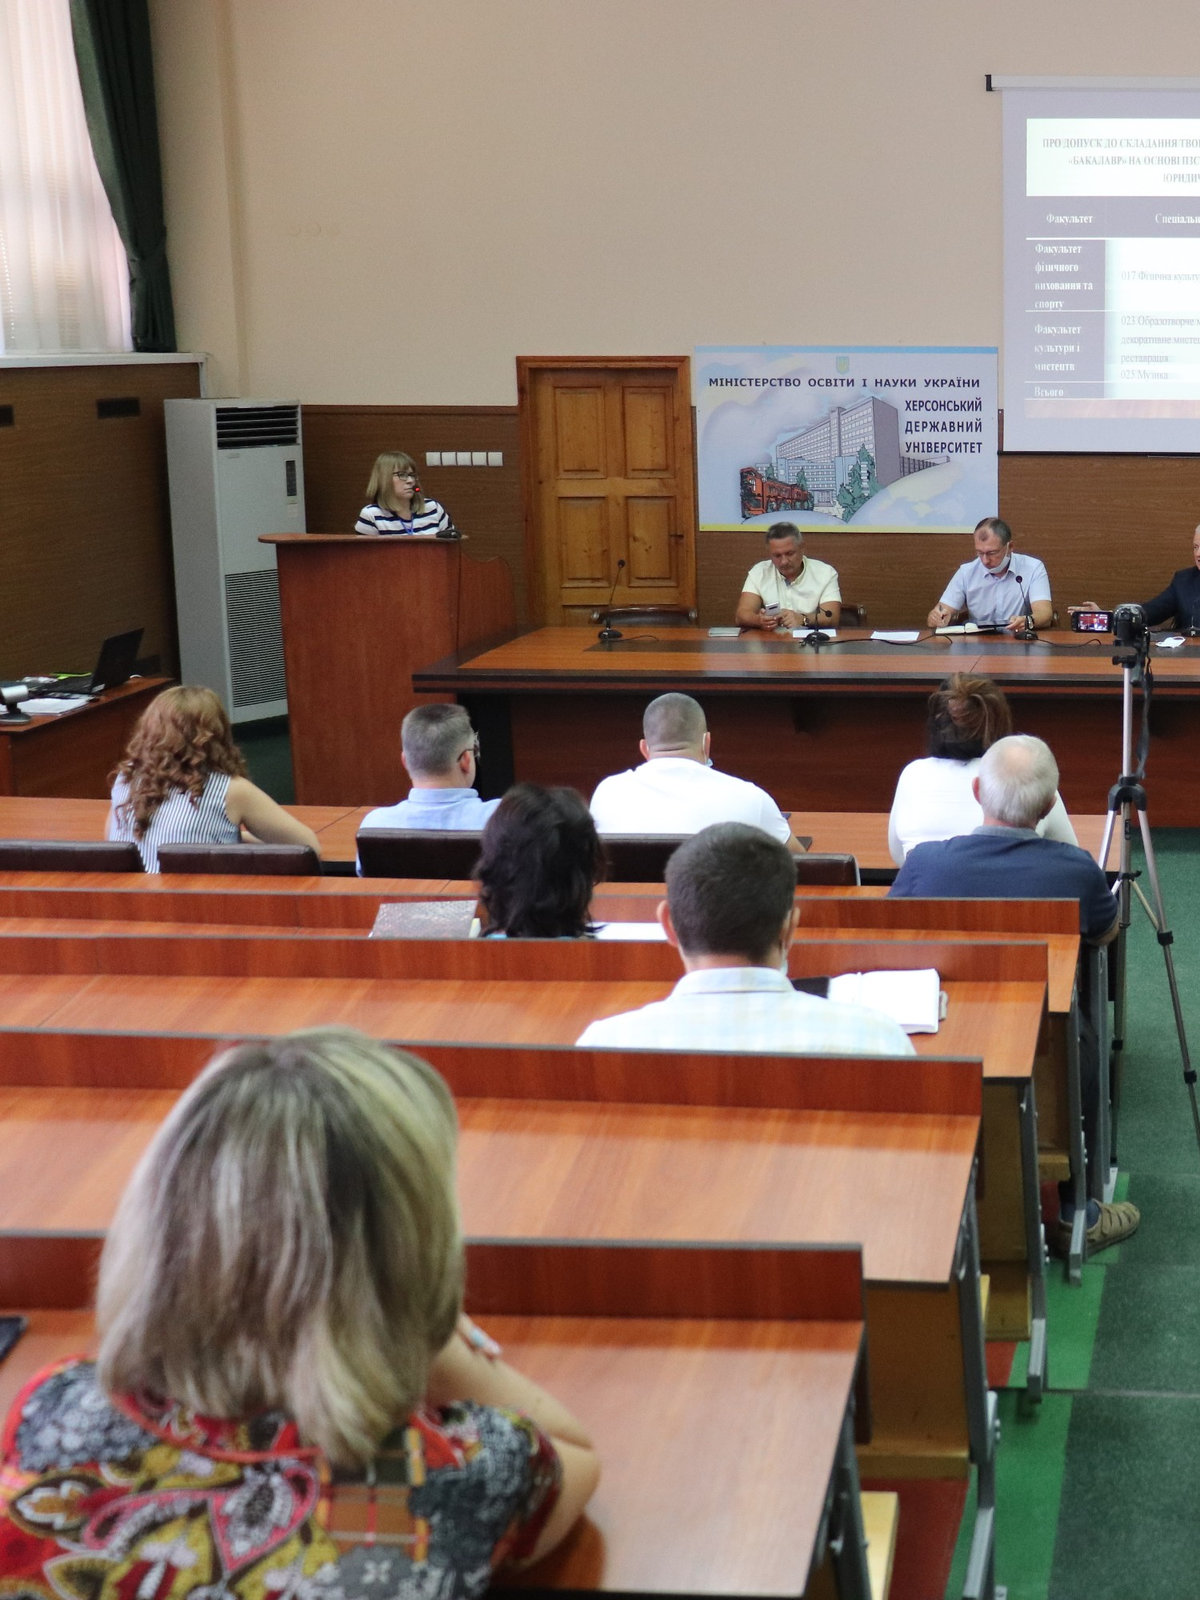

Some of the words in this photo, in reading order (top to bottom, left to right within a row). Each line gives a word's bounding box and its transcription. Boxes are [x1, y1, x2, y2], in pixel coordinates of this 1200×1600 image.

[1042, 138, 1062, 149] ПРО
[1062, 138, 1102, 150] ДОПУСК
[1103, 138, 1118, 149] ДО
[1119, 138, 1177, 150] СКЛАДАННЯ
[1128, 156, 1142, 166] НА
[1143, 156, 1181, 166] ОСНОВІ
[1046, 213, 1094, 225] Факультет
[1035, 243, 1082, 256] Факультет
[1034, 280, 1082, 291] виховання
[1083, 281, 1094, 291] та
[1034, 324, 1082, 336] Факультет
[708, 377, 801, 388] МІНІСТЕРСТВО
[807, 378, 855, 388] ОСВІТИ
[861, 378, 867, 388] І
[874, 378, 917, 388] НАУКИ
[923, 376, 980, 388] УКРАЇНИ
[1034, 386, 1064, 398] Всього
[904, 397, 983, 412] ХЕРСОНСЬКИЙ
[904, 418, 983, 434] ДЕРЖАВНИЙ
[905, 441, 983, 454] УНІВЕРСИТЕТ
